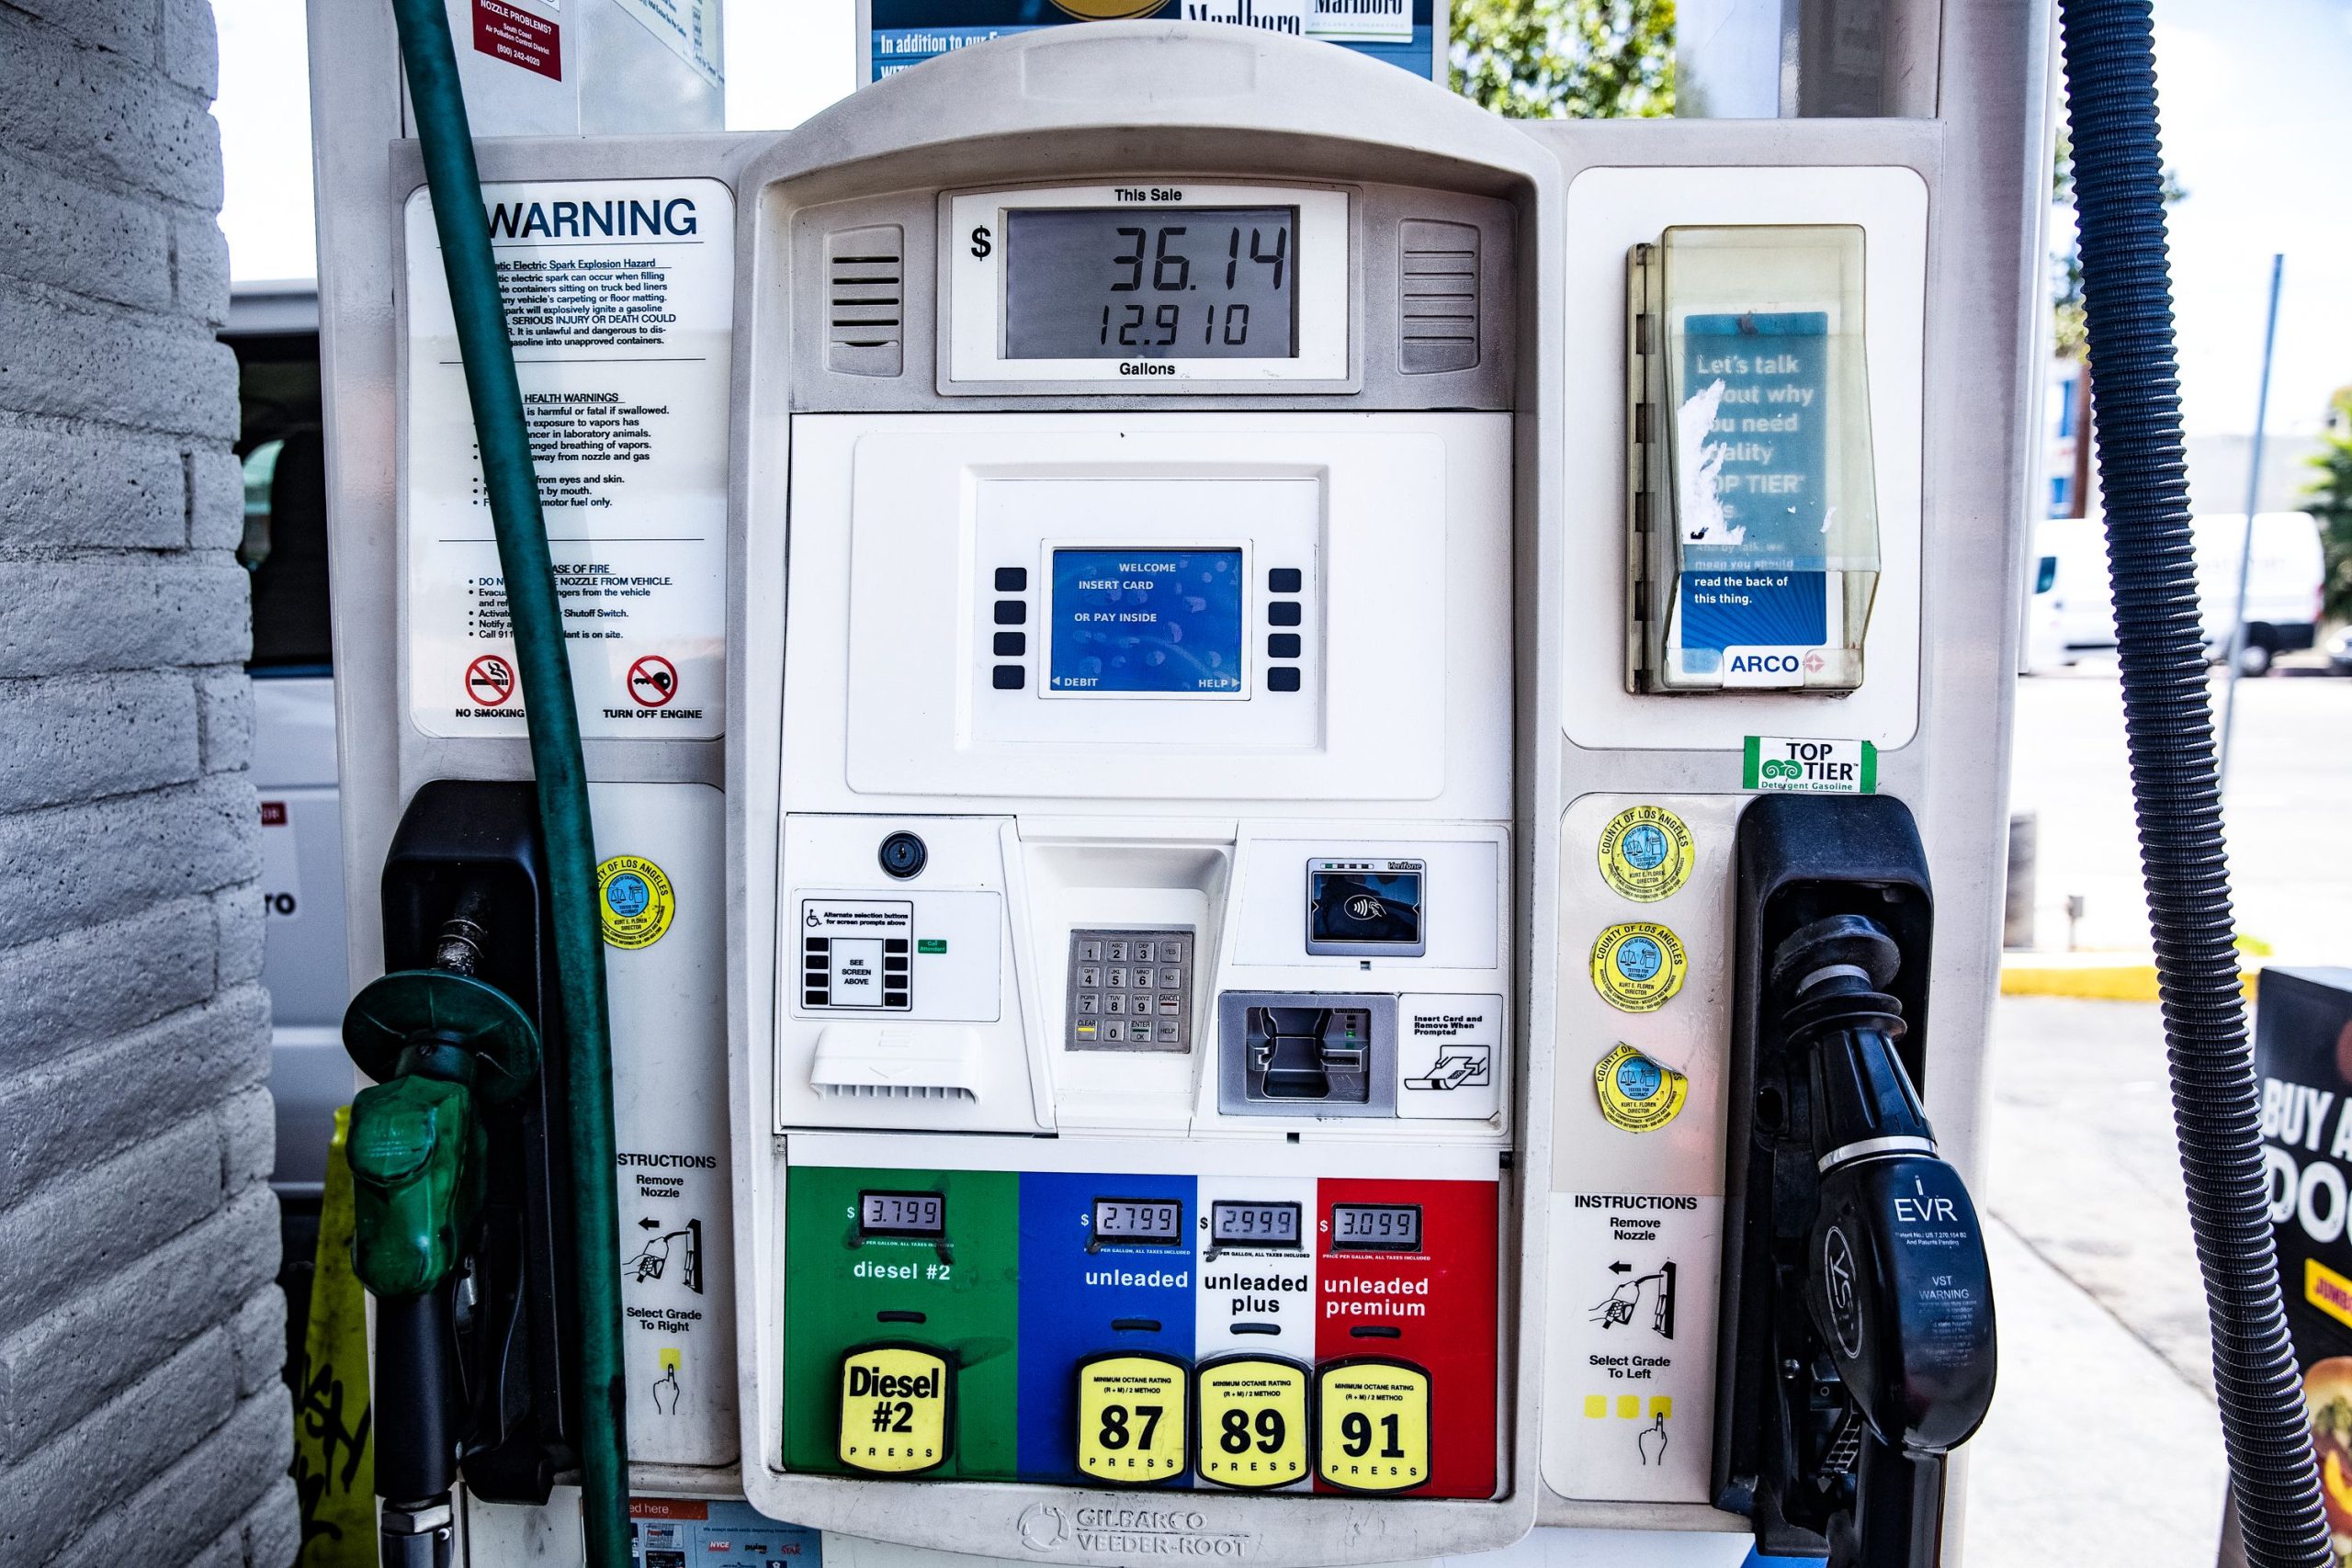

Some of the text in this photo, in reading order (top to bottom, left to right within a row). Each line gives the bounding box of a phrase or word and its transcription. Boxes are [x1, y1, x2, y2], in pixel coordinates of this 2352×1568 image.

[481, 0, 552, 35] NOZZLE PROBLEMS?
[503, 22, 532, 39] South Coast
[493, 28, 514, 42] Pollution
[515, 36, 533, 48] Control
[533, 42, 549, 55] District
[881, 33, 947, 54] In addition
[497, 43, 540, 67] (800) 242-4020
[1114, 188, 1182, 202] This Sale
[483, 197, 697, 238] WARNING
[971, 225, 991, 261] $
[514, 258, 656, 271] Electric Spark Explosion Hazard
[1110, 227, 1286, 291] 36.14
[1101, 304, 1250, 345] 12.910
[1118, 362, 1175, 376] Gallons
[1696, 355, 1800, 375] Let's talk
[525, 393, 618, 402] HEALTH WARNINGS
[1768, 385, 1814, 406] why
[527, 407, 536, 415] is
[537, 407, 572, 416] harmful
[587, 406, 607, 415] fatal
[609, 406, 616, 415] if
[618, 406, 670, 415] swallowed.
[1742, 414, 1798, 433] need
[572, 565, 610, 573] OF FIRE
[1119, 563, 1176, 572] WELCOME
[560, 577, 673, 586] NOZZLE FROM VEHICLE.
[1079, 581, 1154, 590] INSERT CARD
[1694, 576, 1788, 586] read the back of
[1694, 593, 1752, 605] this thing.
[564, 608, 629, 617] Shutoff Switch.
[1075, 613, 1157, 622] OR PAY INSIDE
[1730, 655, 1799, 672] ARCO
[1064, 677, 1228, 688] DEBIT HELP
[456, 708, 525, 718] NO SMOKING
[603, 709, 703, 718] TURN OFF ENGINE
[1786, 742, 1833, 761] TOP
[1761, 781, 1853, 791] Detergent Gasoline
[1601, 819, 1623, 854] COUNTY
[1623, 811, 1635, 823] OF
[1638, 809, 1657, 819] LOS
[1658, 813, 1689, 848] ANGELES
[1387, 861, 1421, 871] Verifone
[607, 859, 669, 897] OF LOS ANGELES
[1114, 950, 1120, 958] 2
[1140, 950, 1147, 959] 3
[1085, 976, 1091, 984] 4
[1113, 976, 1119, 985] 5
[1139, 976, 1146, 986] 6
[1084, 1001, 1091, 1010] 7
[1111, 1002, 1118, 1011] 8
[1138, 1002, 1145, 1011] 9
[1110, 1029, 1117, 1038] 0
[2263, 1077, 2335, 1152] BUY
[636, 1174, 684, 1186] Remove
[640, 1187, 680, 1198] Nozzle
[1574, 1195, 1698, 1210] INSTRUCTIONS
[1894, 1198, 1958, 1222] EVR
[872, 1200, 936, 1224] 3.799
[1103, 1206, 1171, 1231] 2.799
[1222, 1210, 1291, 1234] 2.999
[1343, 1212, 1410, 1235] 3.099
[1610, 1217, 1661, 1228] Remove
[1613, 1229, 1656, 1241] Nozzle
[854, 1262, 950, 1280] diesel #2
[1086, 1269, 1188, 1288] unleaded
[1204, 1273, 1307, 1292] unleaded
[1325, 1277, 1429, 1294] unleaded
[1932, 1276, 1952, 1286] VST
[1919, 1289, 1969, 1300] WARNING
[1232, 1295, 1280, 1315] plus
[1327, 1299, 1425, 1318] premium
[627, 1307, 702, 1320] Select Grade
[639, 1320, 689, 1334] To Right
[1589, 1355, 1671, 1368] Select Grade
[1608, 1368, 1651, 1379] To Left
[850, 1366, 939, 1398] Diesel
[872, 1402, 913, 1433] #2
[1099, 1404, 1163, 1450] 87
[1220, 1408, 1285, 1454] 89
[1341, 1412, 1405, 1458] 91
[644, 1505, 669, 1514] here
[1077, 1508, 1207, 1530] GILBARCO
[709, 1540, 730, 1549] NYCE
[1077, 1534, 1250, 1557] VEEDER-ROOT
